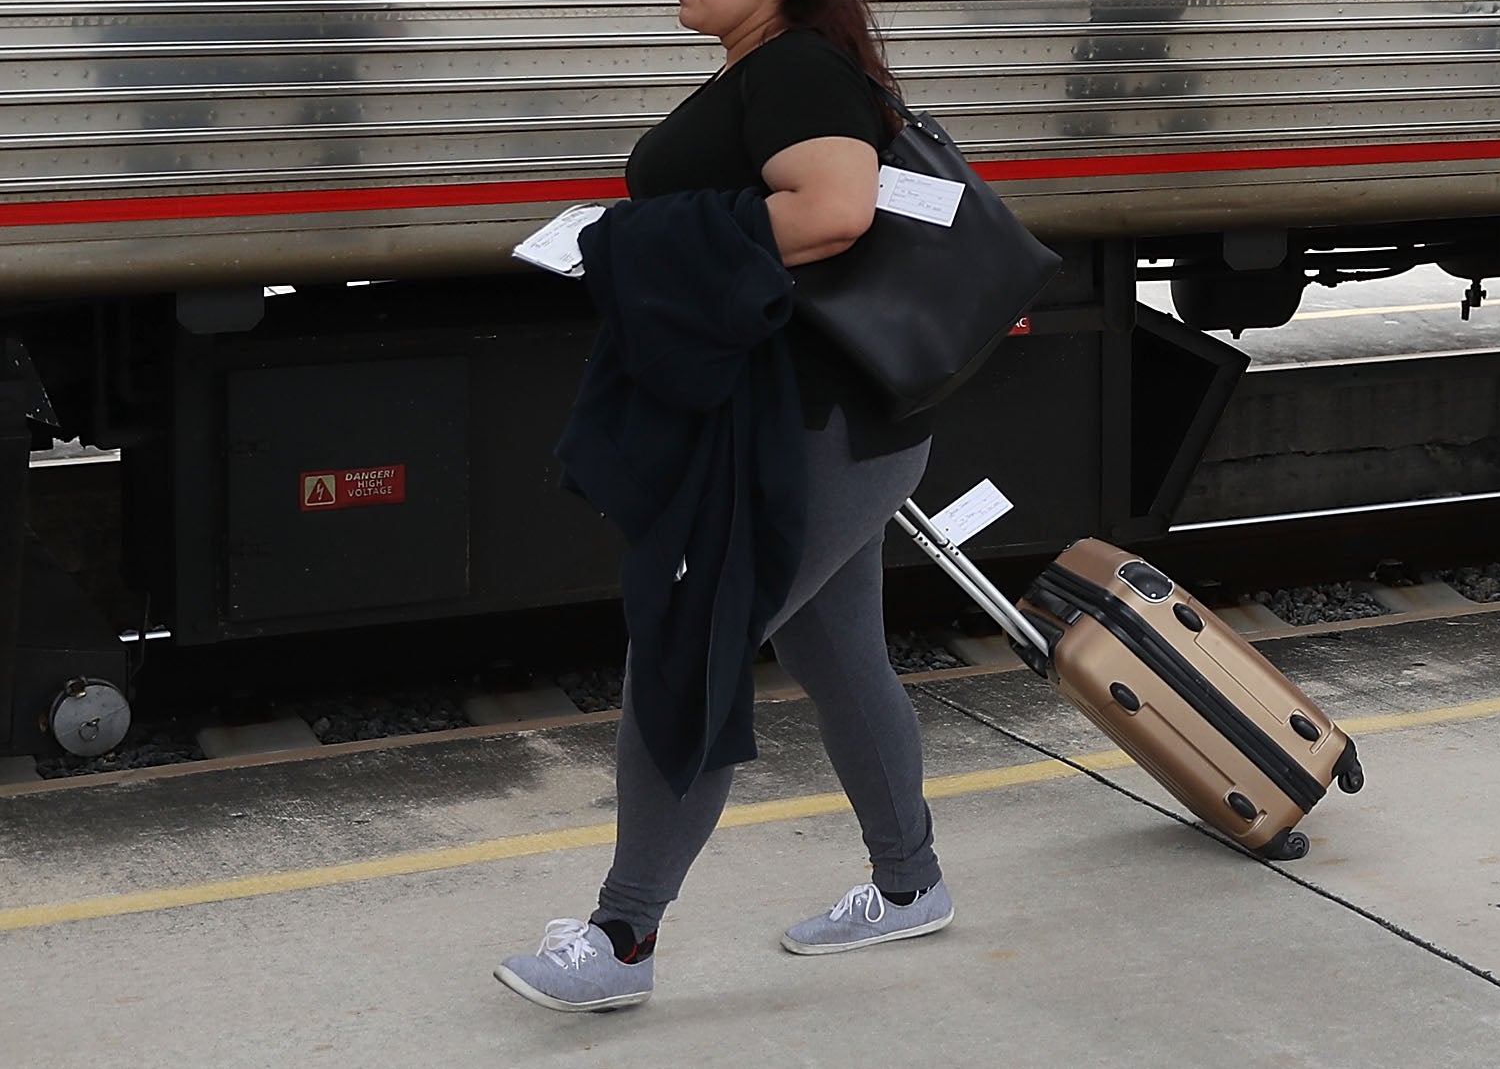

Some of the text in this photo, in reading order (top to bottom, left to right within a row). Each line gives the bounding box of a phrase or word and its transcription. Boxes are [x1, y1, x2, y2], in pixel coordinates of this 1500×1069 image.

[345, 470, 395, 481] DANGER!
[357, 479, 383, 488] HIGH
[348, 486, 392, 497] VOLTAGE
